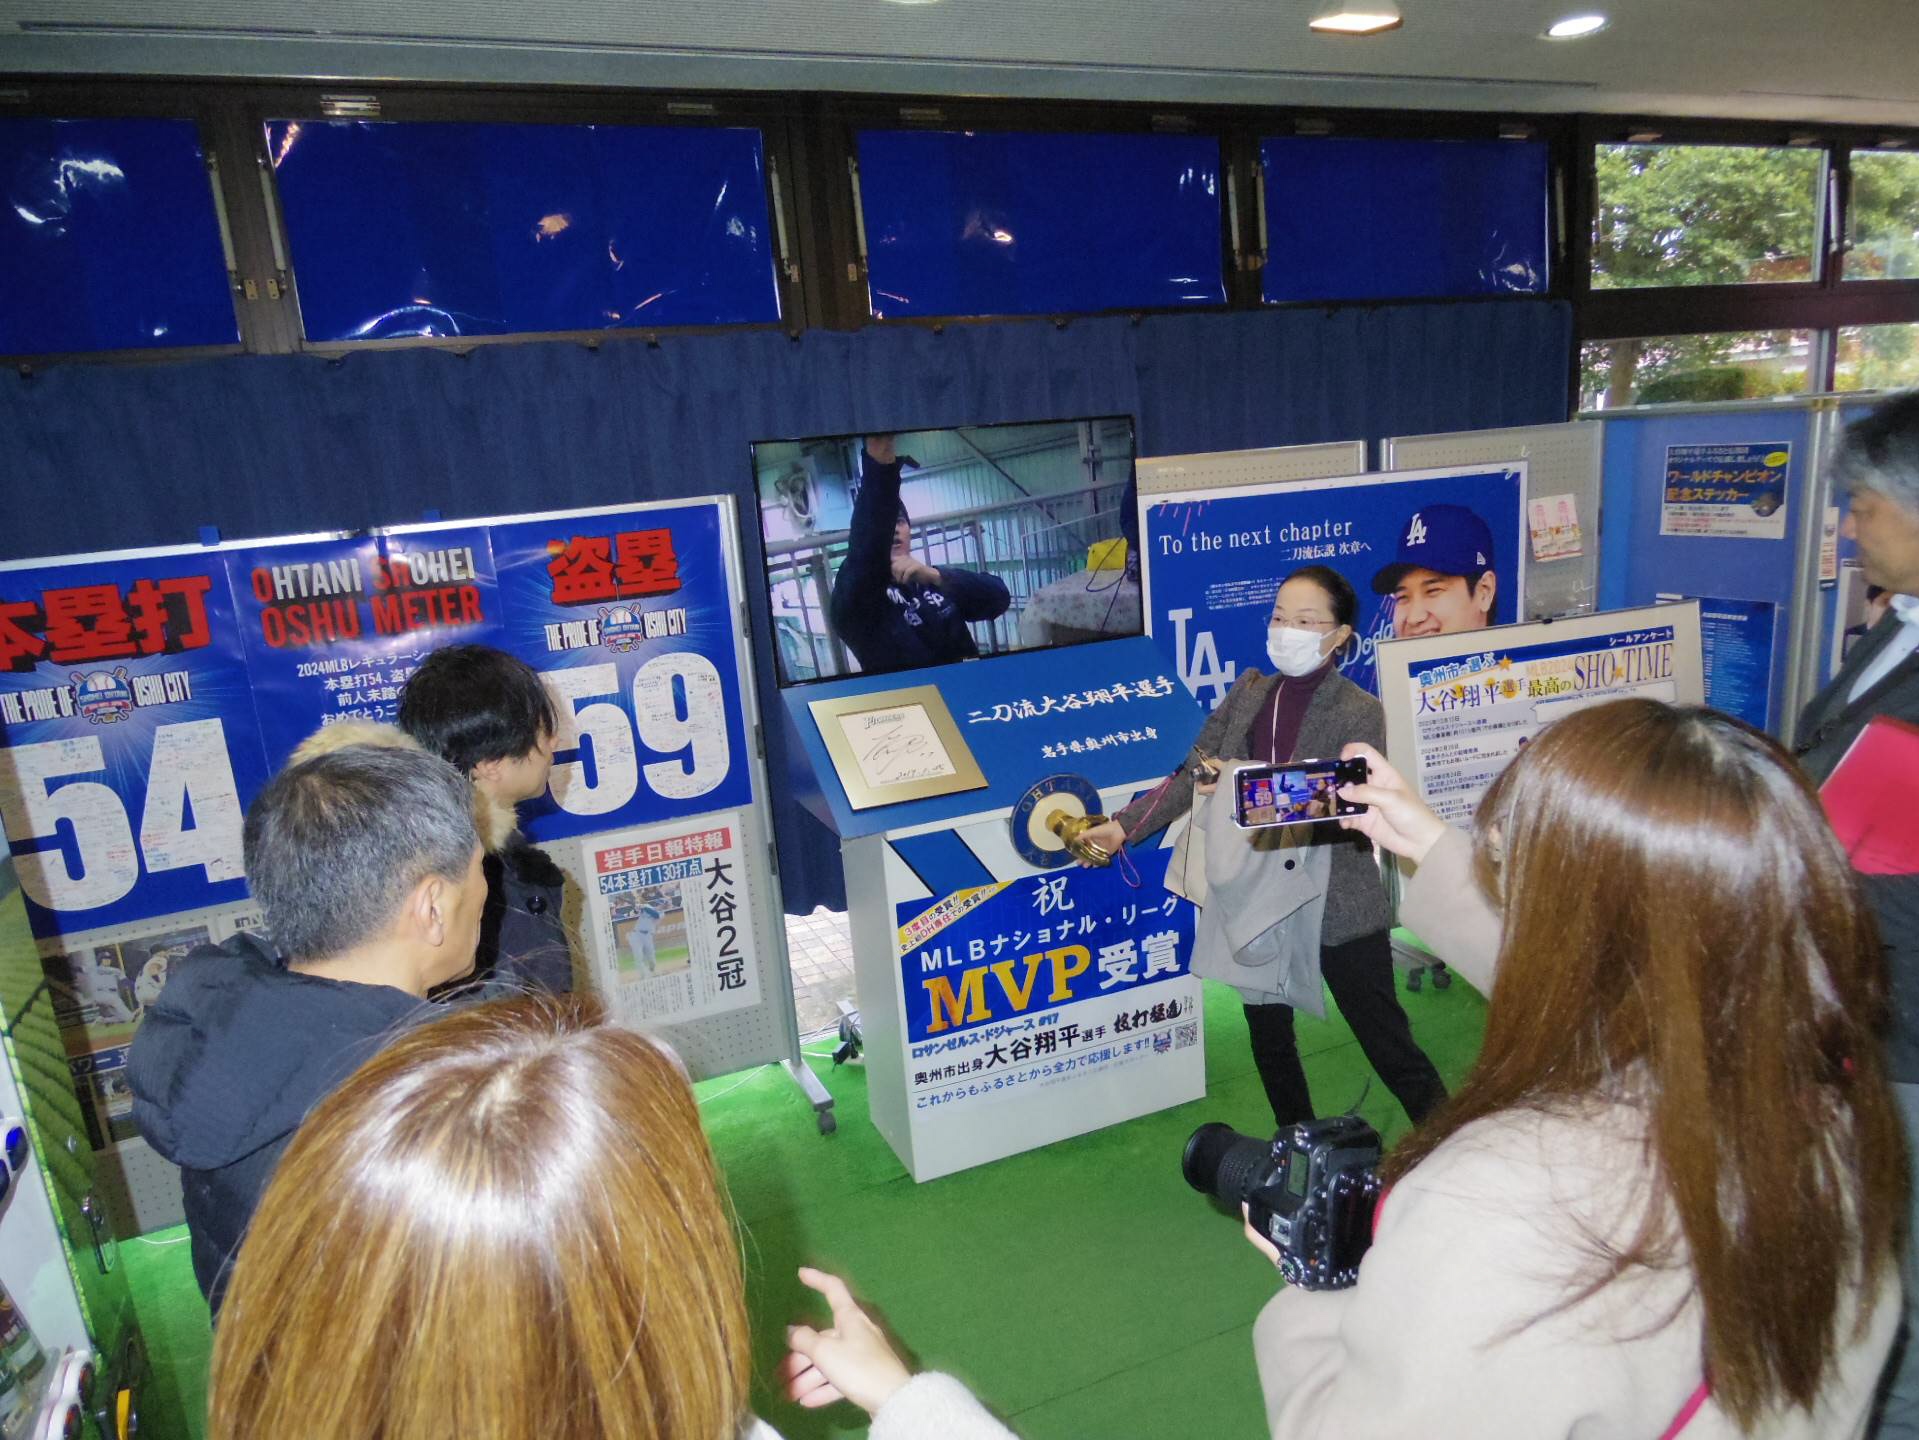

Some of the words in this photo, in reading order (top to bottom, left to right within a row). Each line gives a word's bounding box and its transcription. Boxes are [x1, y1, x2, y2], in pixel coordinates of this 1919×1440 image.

[1158, 535, 1183, 556] To
[1191, 531, 1223, 552] the
[1229, 524, 1271, 549] next
[1279, 518, 1353, 542] chapter
[1280, 543, 1336, 562] 二刀流伝説
[1338, 540, 1373, 556] 次章へ
[251, 557, 361, 603] OHTANI
[372, 546, 477, 591] SHOHEI
[547, 528, 683, 605] 盗塁
[260, 602, 361, 649] OSHU
[372, 586, 485, 637] METER
[544, 624, 564, 652] THE
[562, 620, 589, 650] PRIDE
[588, 618, 601, 646] OF
[643, 610, 669, 639] OSHU
[667, 607, 687, 636] CITY
[1608, 630, 1674, 647] シールアンケート
[1, 691, 26, 725] THE
[22, 687, 61, 722] PRIDE
[57, 685, 74, 717] OF
[132, 673, 167, 707] OSHU
[164, 670, 192, 703] CITY
[967, 675, 1175, 724] 二刀流大谷翔平選手
[540, 651, 731, 816] 59
[1040, 726, 1159, 759] 岩手県奥州市出身
[0, 717, 247, 912] 54
[603, 830, 725, 870] 岩手日報特報
[600, 868, 654, 894] 54本塁打
[656, 858, 703, 884] 130打点
[1031, 875, 1075, 917] 祝
[704, 857, 747, 992] 大谷2冠
